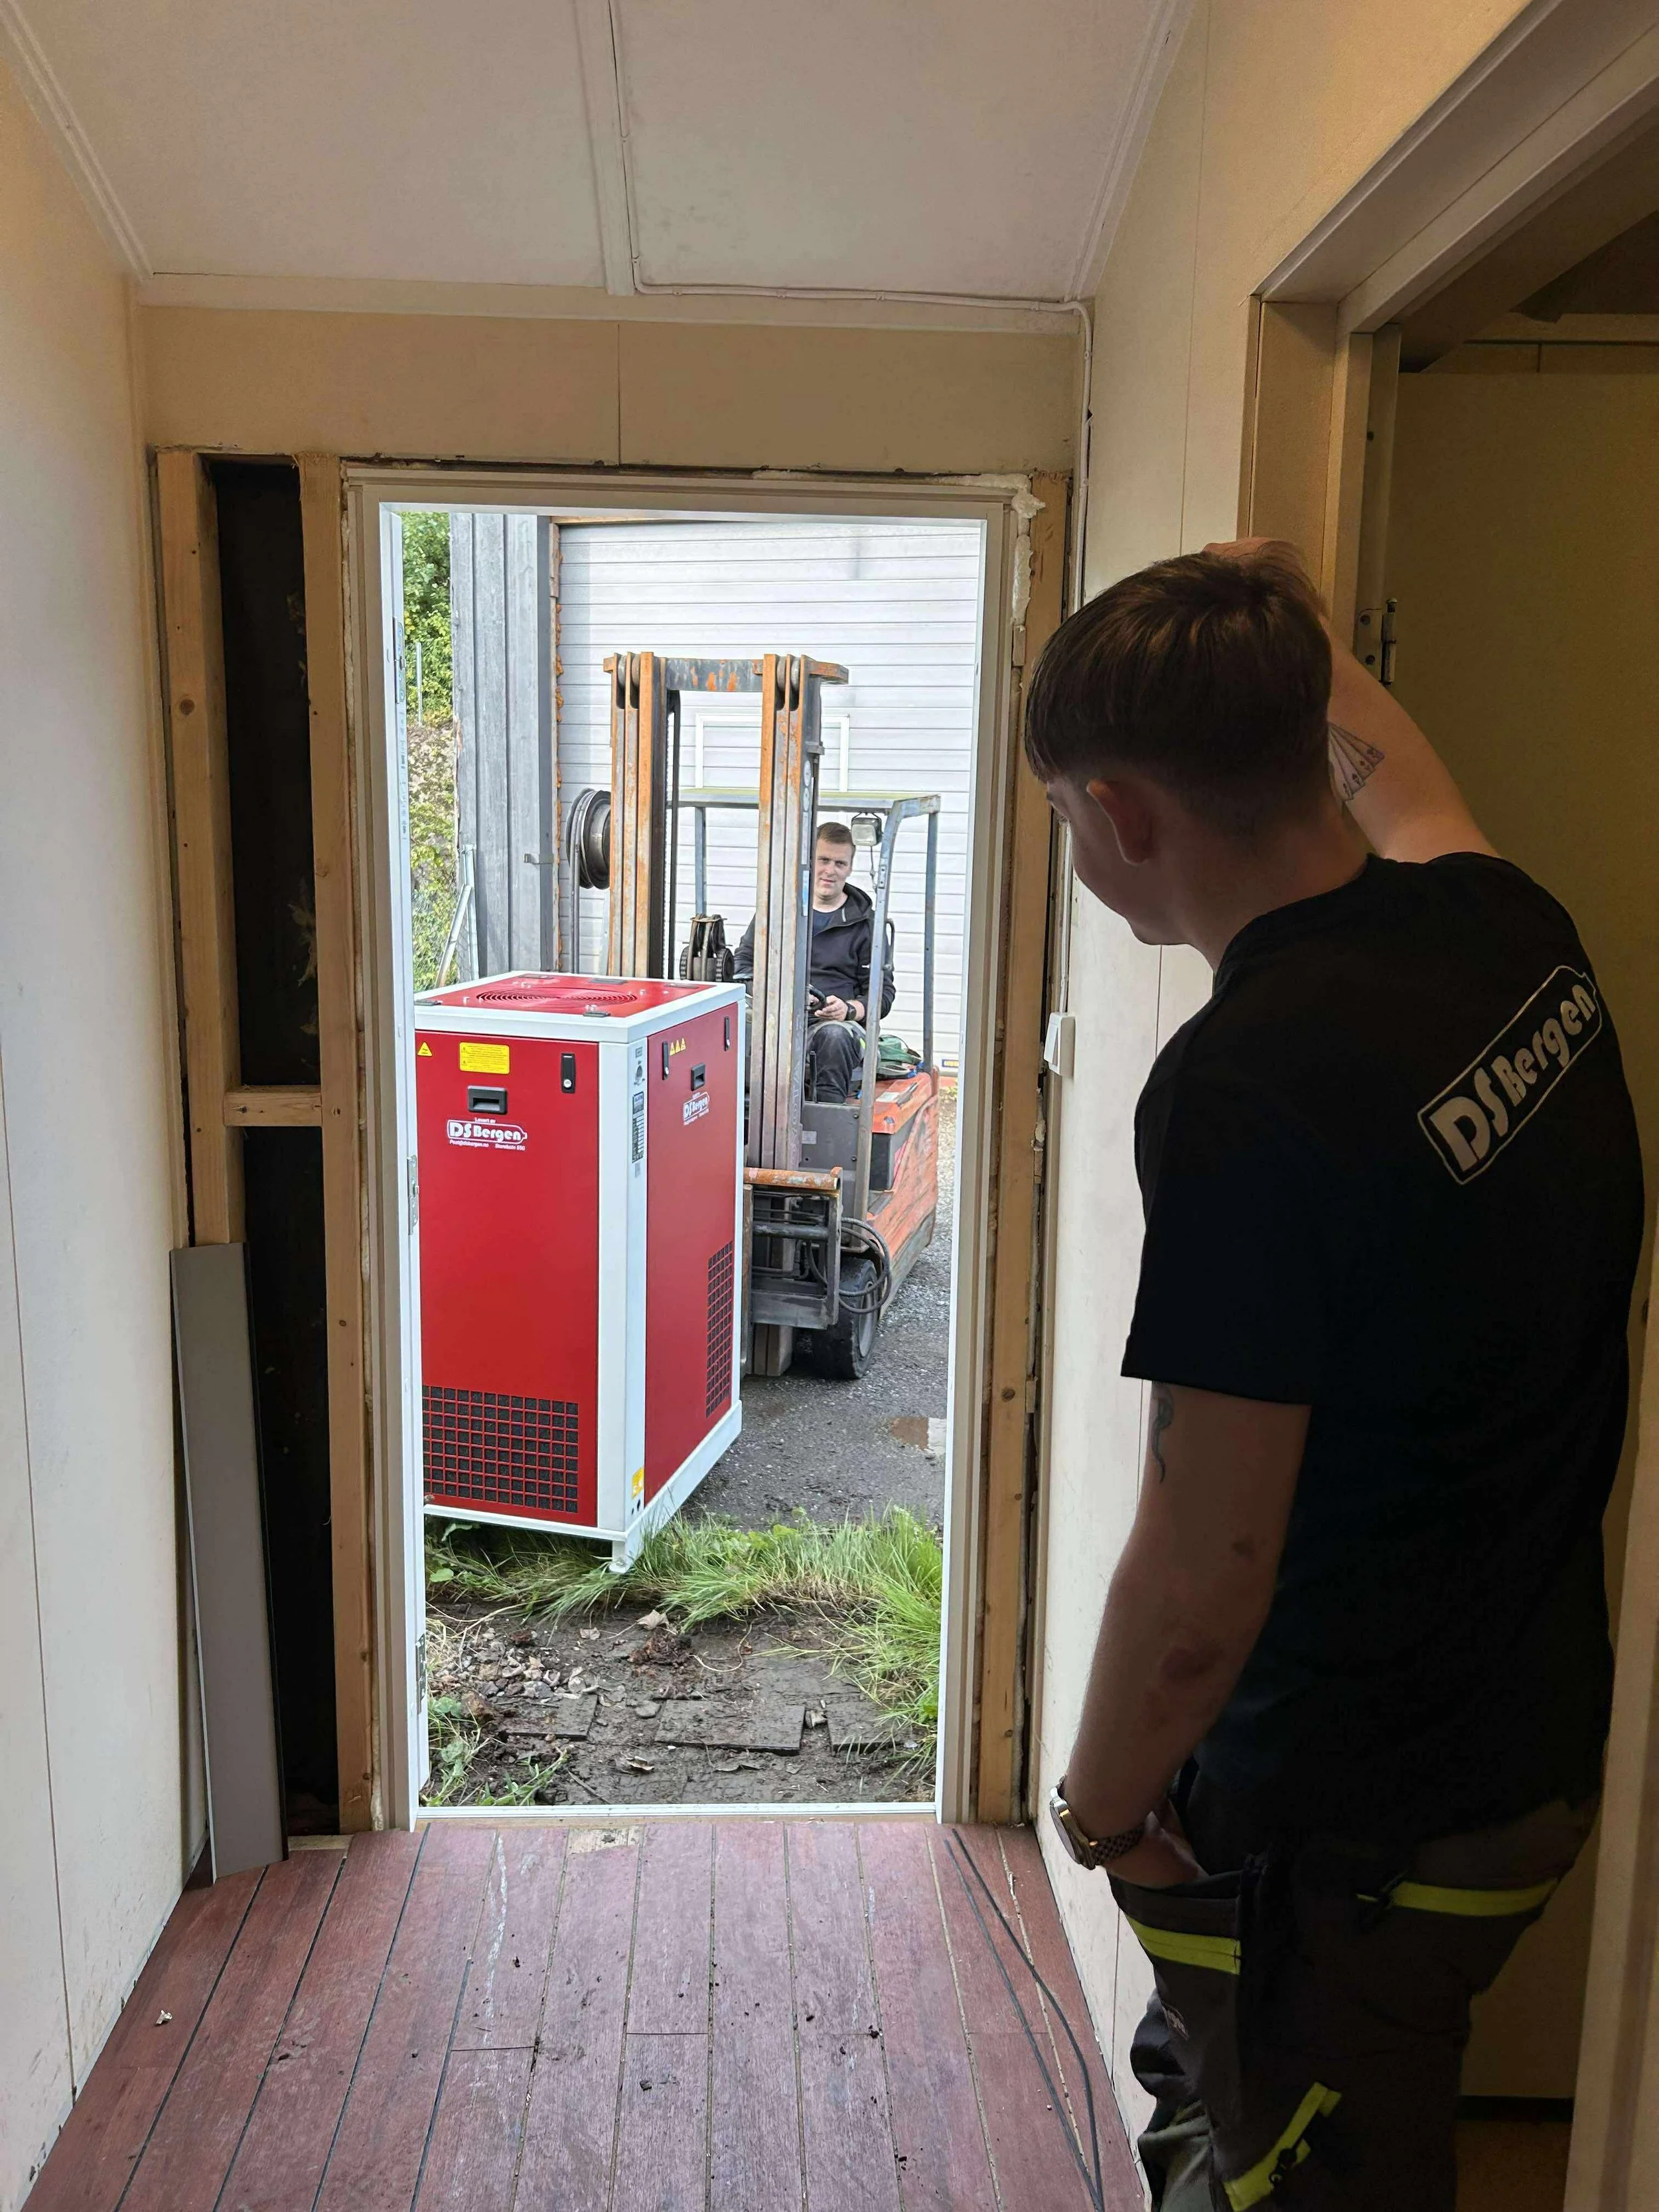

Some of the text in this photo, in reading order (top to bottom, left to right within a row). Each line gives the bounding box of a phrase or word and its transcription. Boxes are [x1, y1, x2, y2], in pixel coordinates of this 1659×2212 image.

[1429, 984, 1596, 1172] DS Bergen
[449, 1122, 521, 1142] DS Bergen
